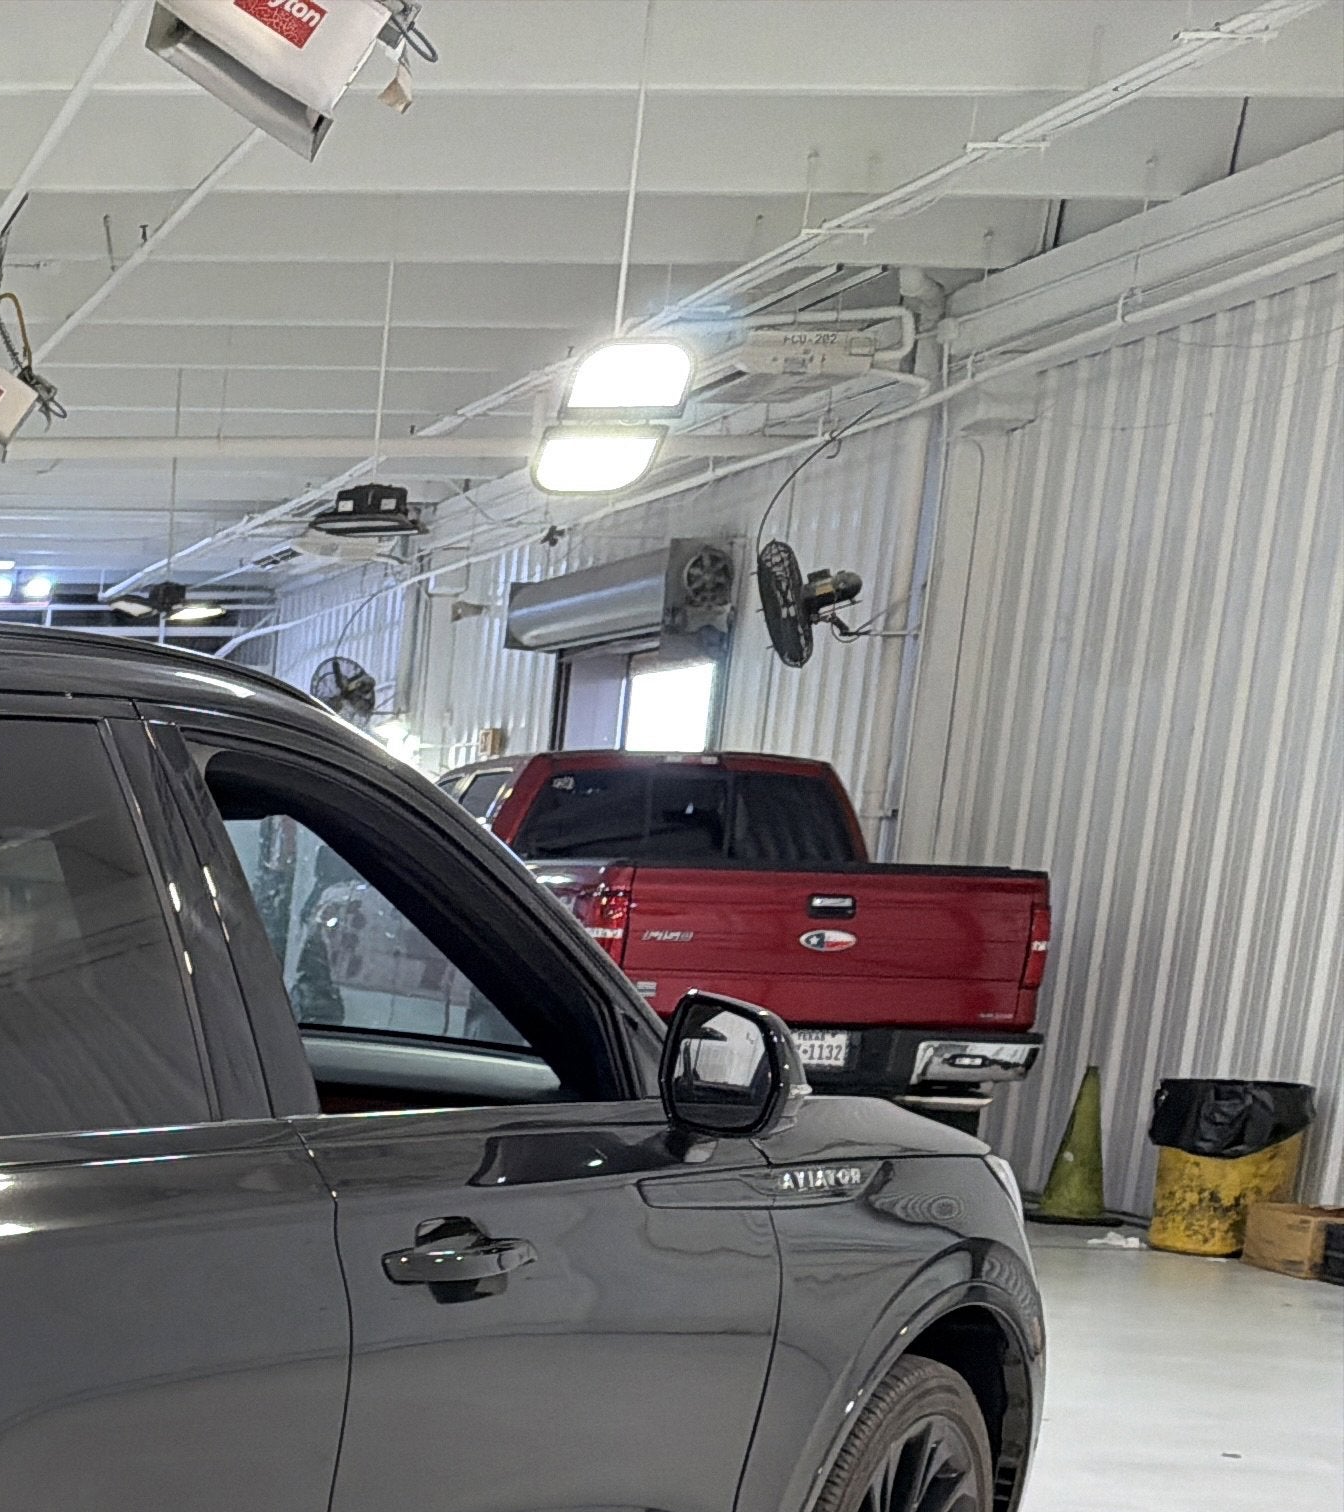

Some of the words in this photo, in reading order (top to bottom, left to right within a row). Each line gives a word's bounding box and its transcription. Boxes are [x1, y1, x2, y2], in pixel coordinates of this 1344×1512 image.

[267, 0, 322, 28] ton
[796, 1043, 843, 1061] 1132
[781, 1167, 861, 1190] AVIATOR
